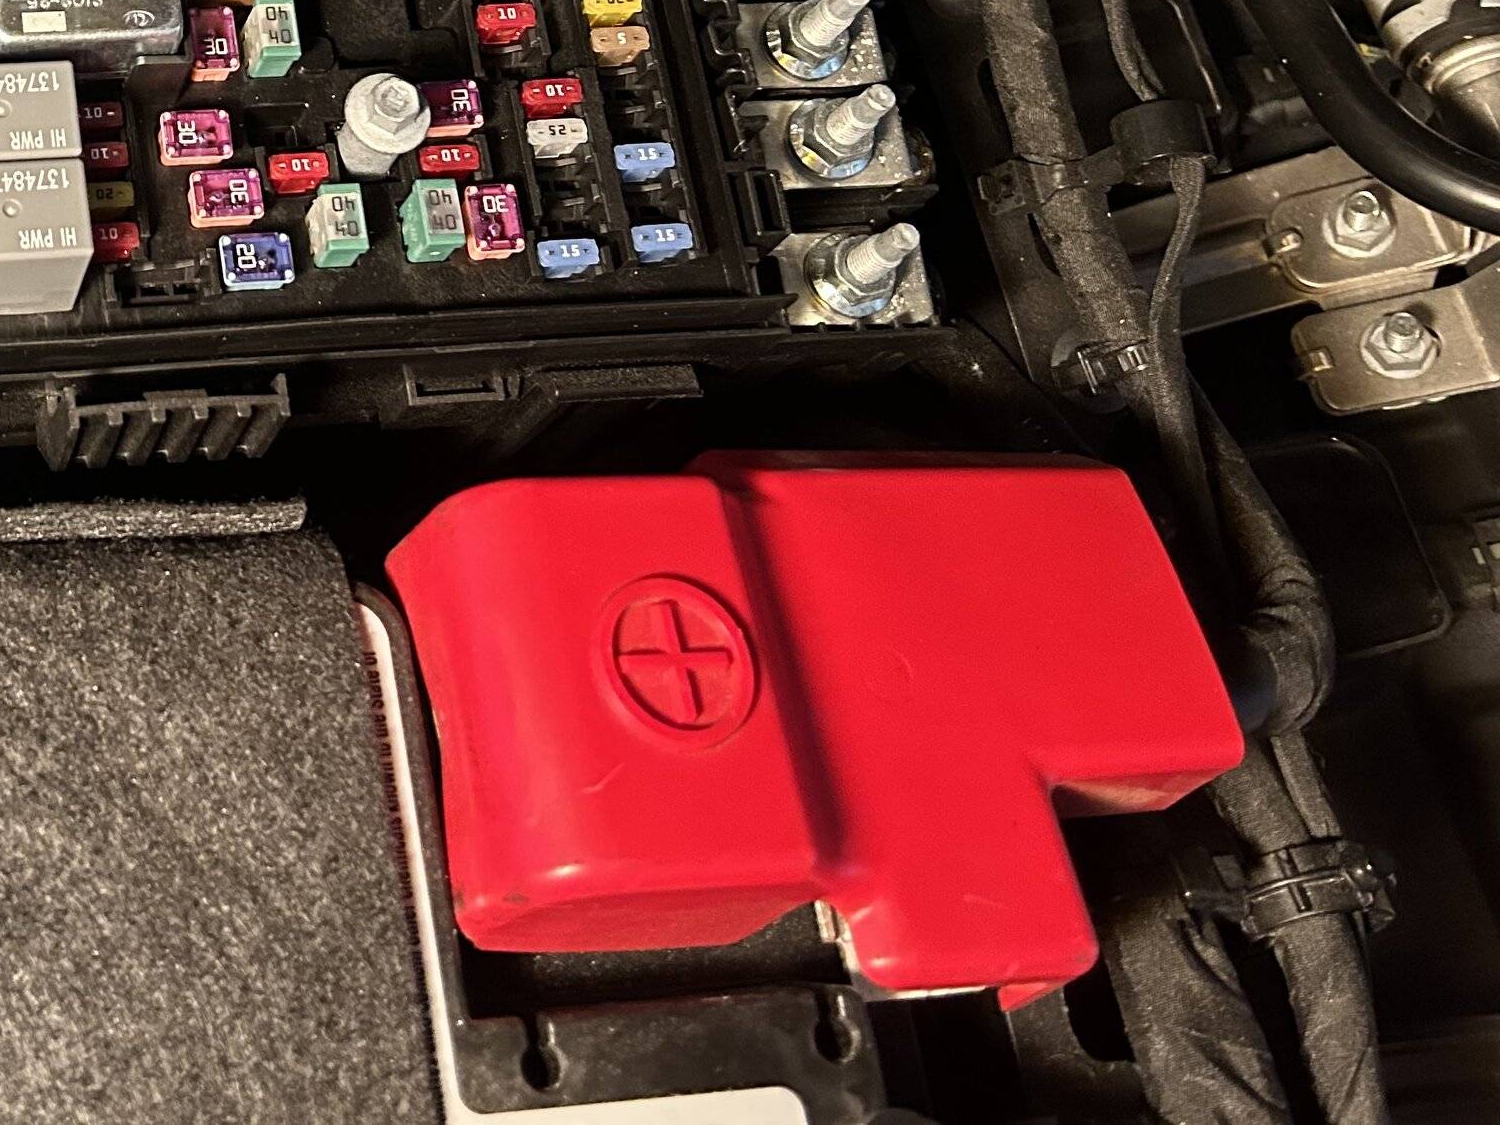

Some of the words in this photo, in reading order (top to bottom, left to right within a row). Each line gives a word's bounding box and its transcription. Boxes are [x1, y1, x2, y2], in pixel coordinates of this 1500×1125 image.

[266, 6, 290, 21] 40
[498, 8, 517, 20] 10
[268, 29, 292, 44] 40
[204, 38, 228, 55] 30
[546, 83, 565, 96] 10
[450, 88, 472, 112] 30
[51, 129, 67, 147] HI
[177, 120, 196, 145] 30
[548, 124, 566, 136] 25
[10, 130, 44, 150] PWR
[441, 150, 462, 162] 10
[638, 149, 657, 160] 15
[292, 158, 311, 172] 10
[228, 179, 250, 204] 30
[428, 190, 452, 206] 40
[332, 196, 355, 212] 40
[482, 195, 510, 212] 30
[100, 228, 118, 240] 10
[334, 220, 358, 236] 40
[655, 230, 675, 242] 15
[20, 229, 54, 250] PWR
[61, 227, 78, 246] HI
[236, 243, 258, 269] 20
[560, 244, 580, 257] 15
